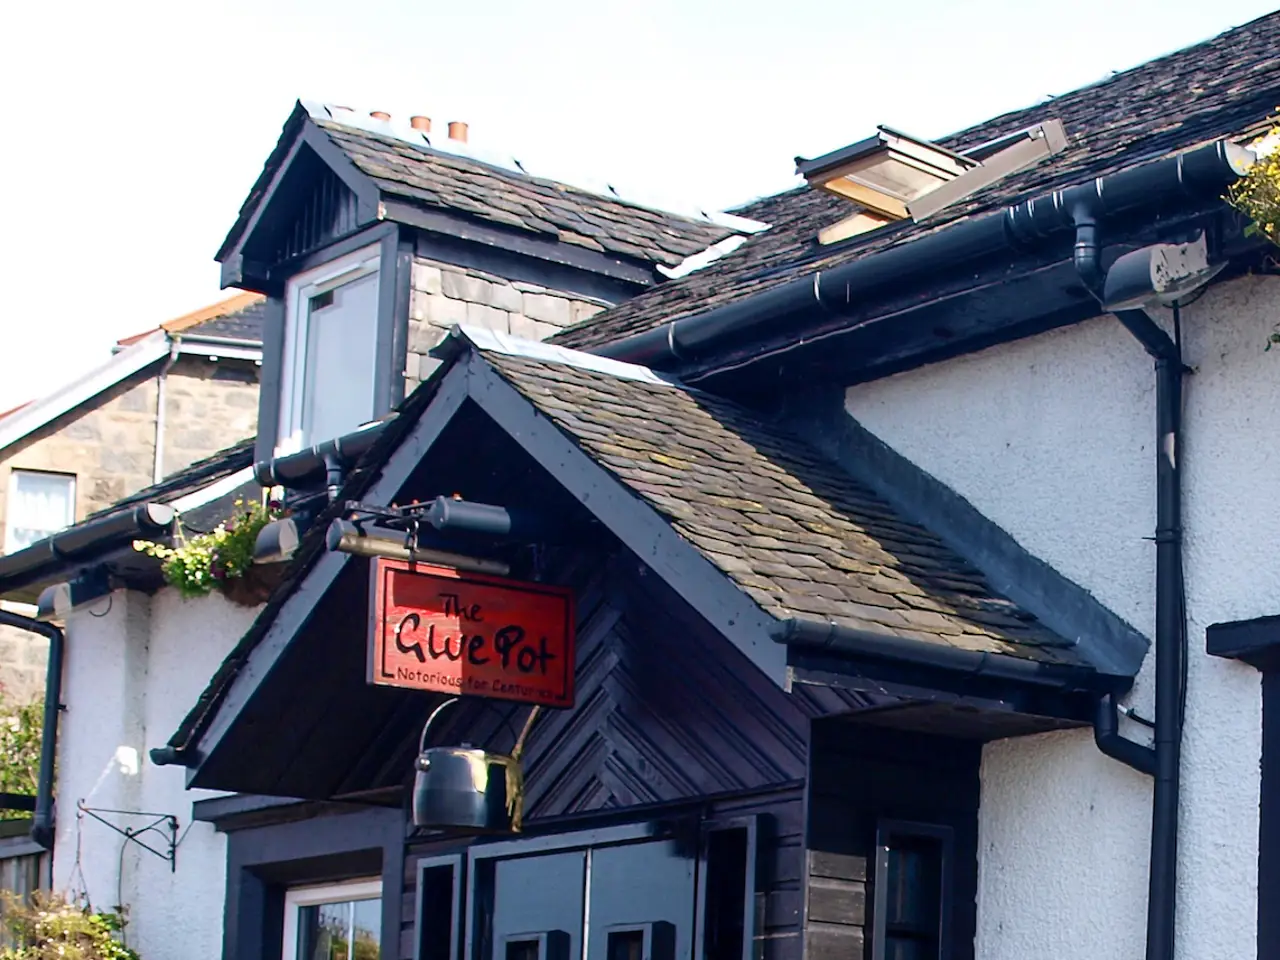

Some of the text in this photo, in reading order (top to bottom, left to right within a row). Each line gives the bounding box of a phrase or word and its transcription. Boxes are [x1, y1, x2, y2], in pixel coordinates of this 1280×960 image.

[438, 592, 484, 622] The
[395, 613, 557, 676] Glue Pot
[397, 666, 463, 689] Notorious
[467, 675, 489, 690] for
